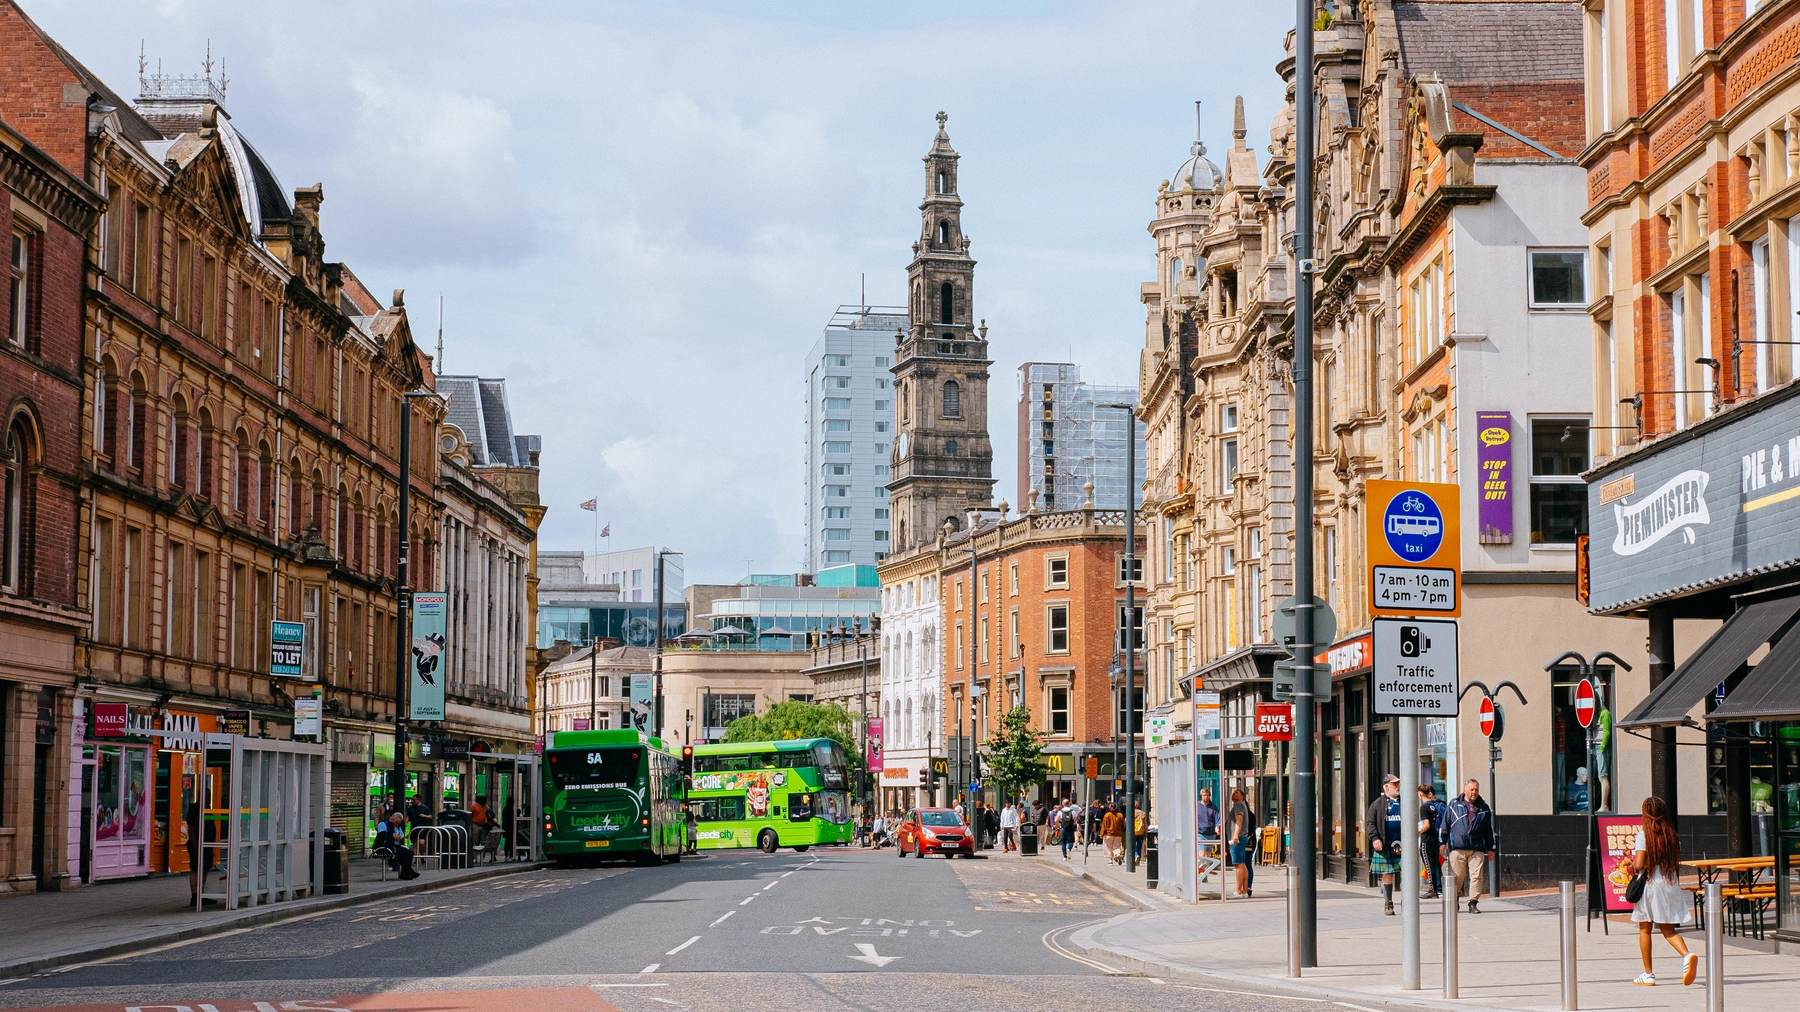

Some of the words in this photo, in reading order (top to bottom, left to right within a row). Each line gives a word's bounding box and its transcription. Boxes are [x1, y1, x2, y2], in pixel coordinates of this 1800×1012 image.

[1482, 460, 1507, 470] STOP
[1742, 448, 1766, 494] PIE
[1770, 444, 1784, 484] &
[1488, 470, 1500, 480] IN
[1483, 480, 1507, 490] GEEK
[1484, 491, 1507, 500] OUT!
[1623, 480, 1700, 547] PIEMINISTER
[1405, 543, 1423, 554] taxi
[1379, 573, 1387, 585] 7
[1388, 576, 1406, 586] am
[1415, 574, 1429, 587] 10
[1432, 577, 1450, 588] am
[1381, 589, 1390, 601] 4
[1393, 592, 1411, 603] pm
[1420, 590, 1428, 602] 7
[1429, 593, 1448, 604] pm
[273, 622, 301, 636] Heaney
[272, 651, 284, 664] TO
[285, 652, 301, 665] LET
[1396, 665, 1435, 678] Traffic
[1379, 680, 1453, 694] enforcement
[1391, 697, 1441, 709] cameras
[96, 714, 125, 724] NAILS
[1260, 715, 1286, 724] FIVE
[1257, 724, 1290, 733] GUYS
[586, 752, 603, 765] 5A
[701, 775, 722, 789] CORE
[1606, 824, 1643, 835] SUNDAY
[1607, 835, 1637, 850] BES
